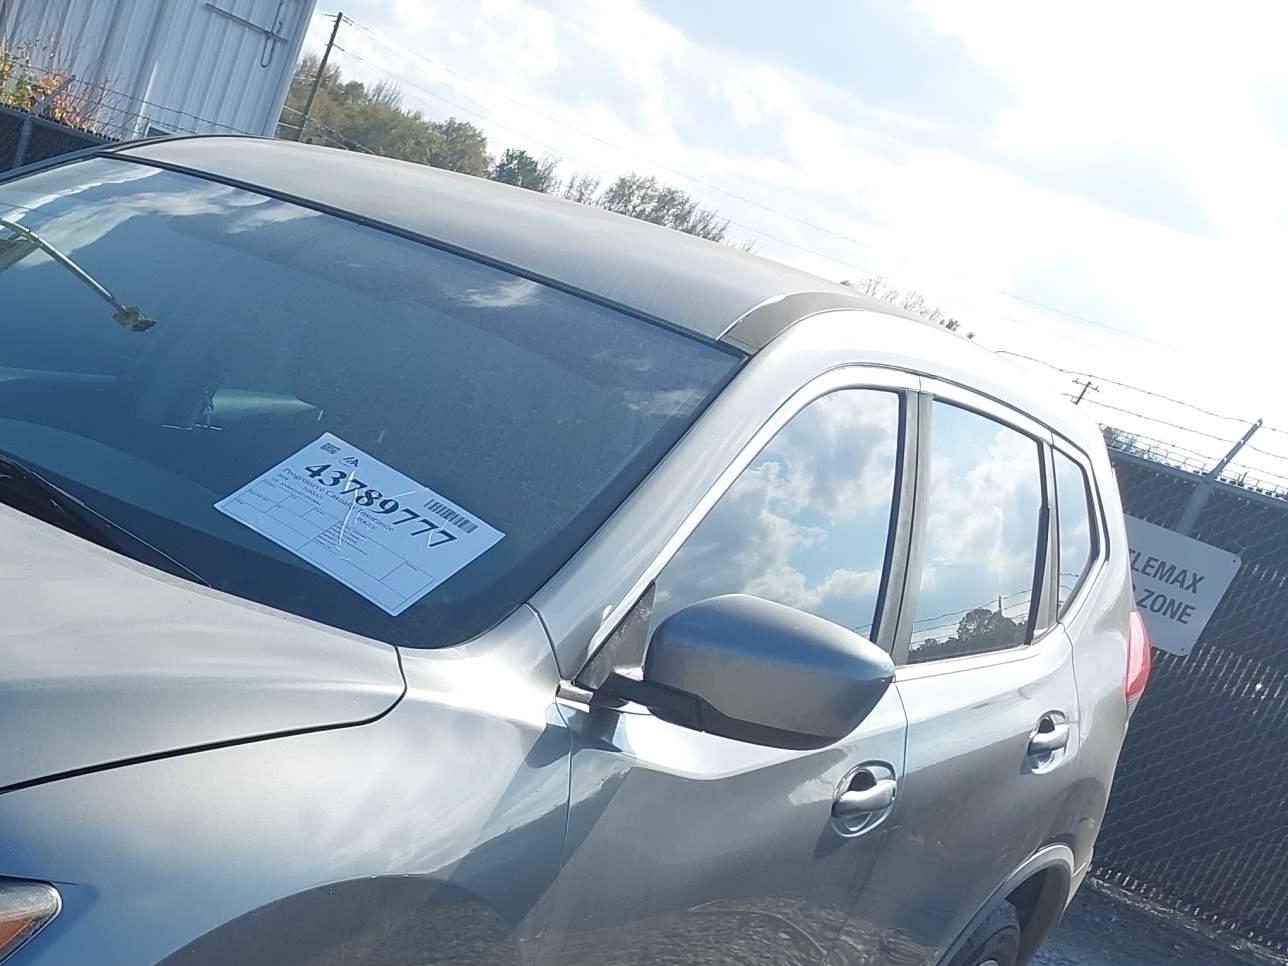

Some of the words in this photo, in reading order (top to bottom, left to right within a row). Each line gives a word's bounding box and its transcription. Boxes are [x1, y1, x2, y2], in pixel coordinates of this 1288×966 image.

[283, 467, 325, 493] Progressive
[356, 508, 394, 531] Insurance
[304, 464, 458, 548] 43789777
[1136, 588, 1196, 625] ZONE
